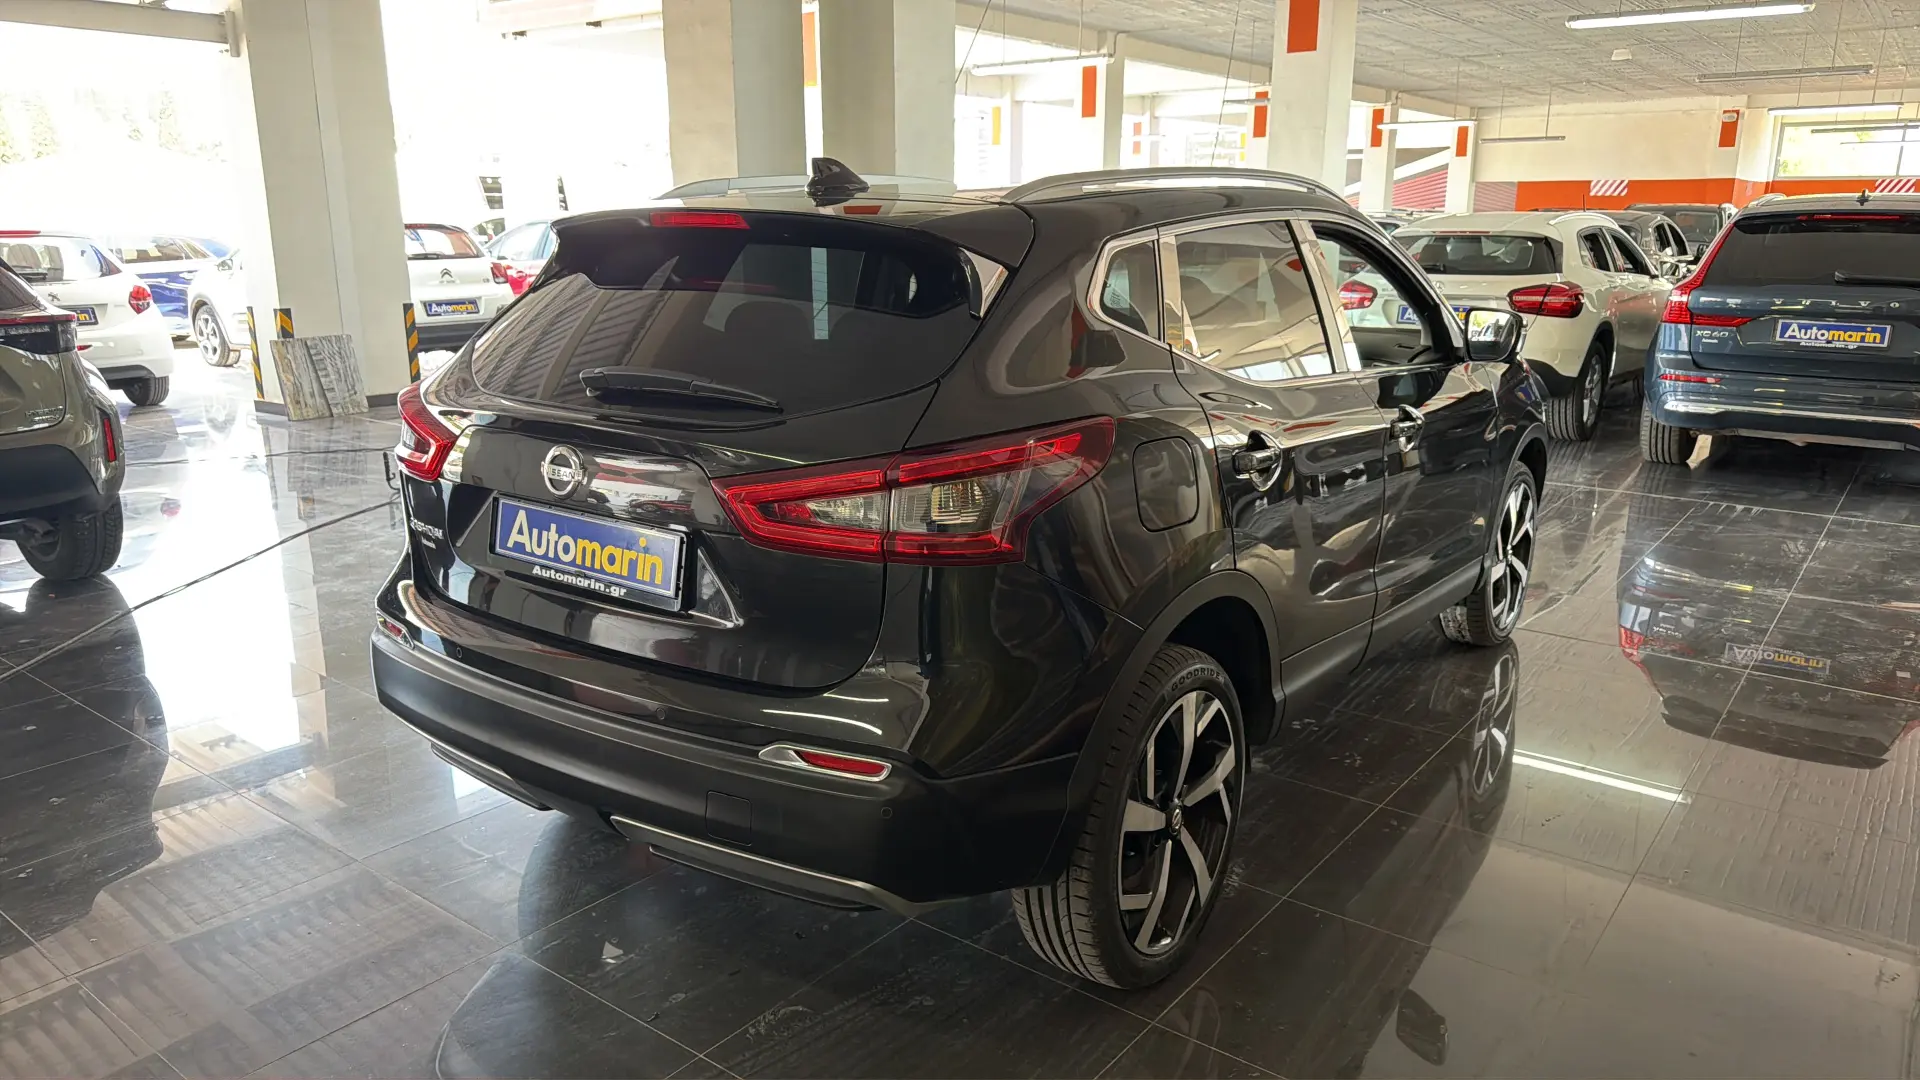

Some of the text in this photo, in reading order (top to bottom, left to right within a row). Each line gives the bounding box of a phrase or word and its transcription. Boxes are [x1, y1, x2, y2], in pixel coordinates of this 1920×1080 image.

[431, 301, 476, 313] Automarin
[1695, 330, 1729, 338] XC60
[1784, 323, 1881, 343] Automarin
[506, 509, 663, 584] Automarin
[532, 565, 627, 597] Automarin.gr
[1171, 667, 1221, 692] GOODRIDE
